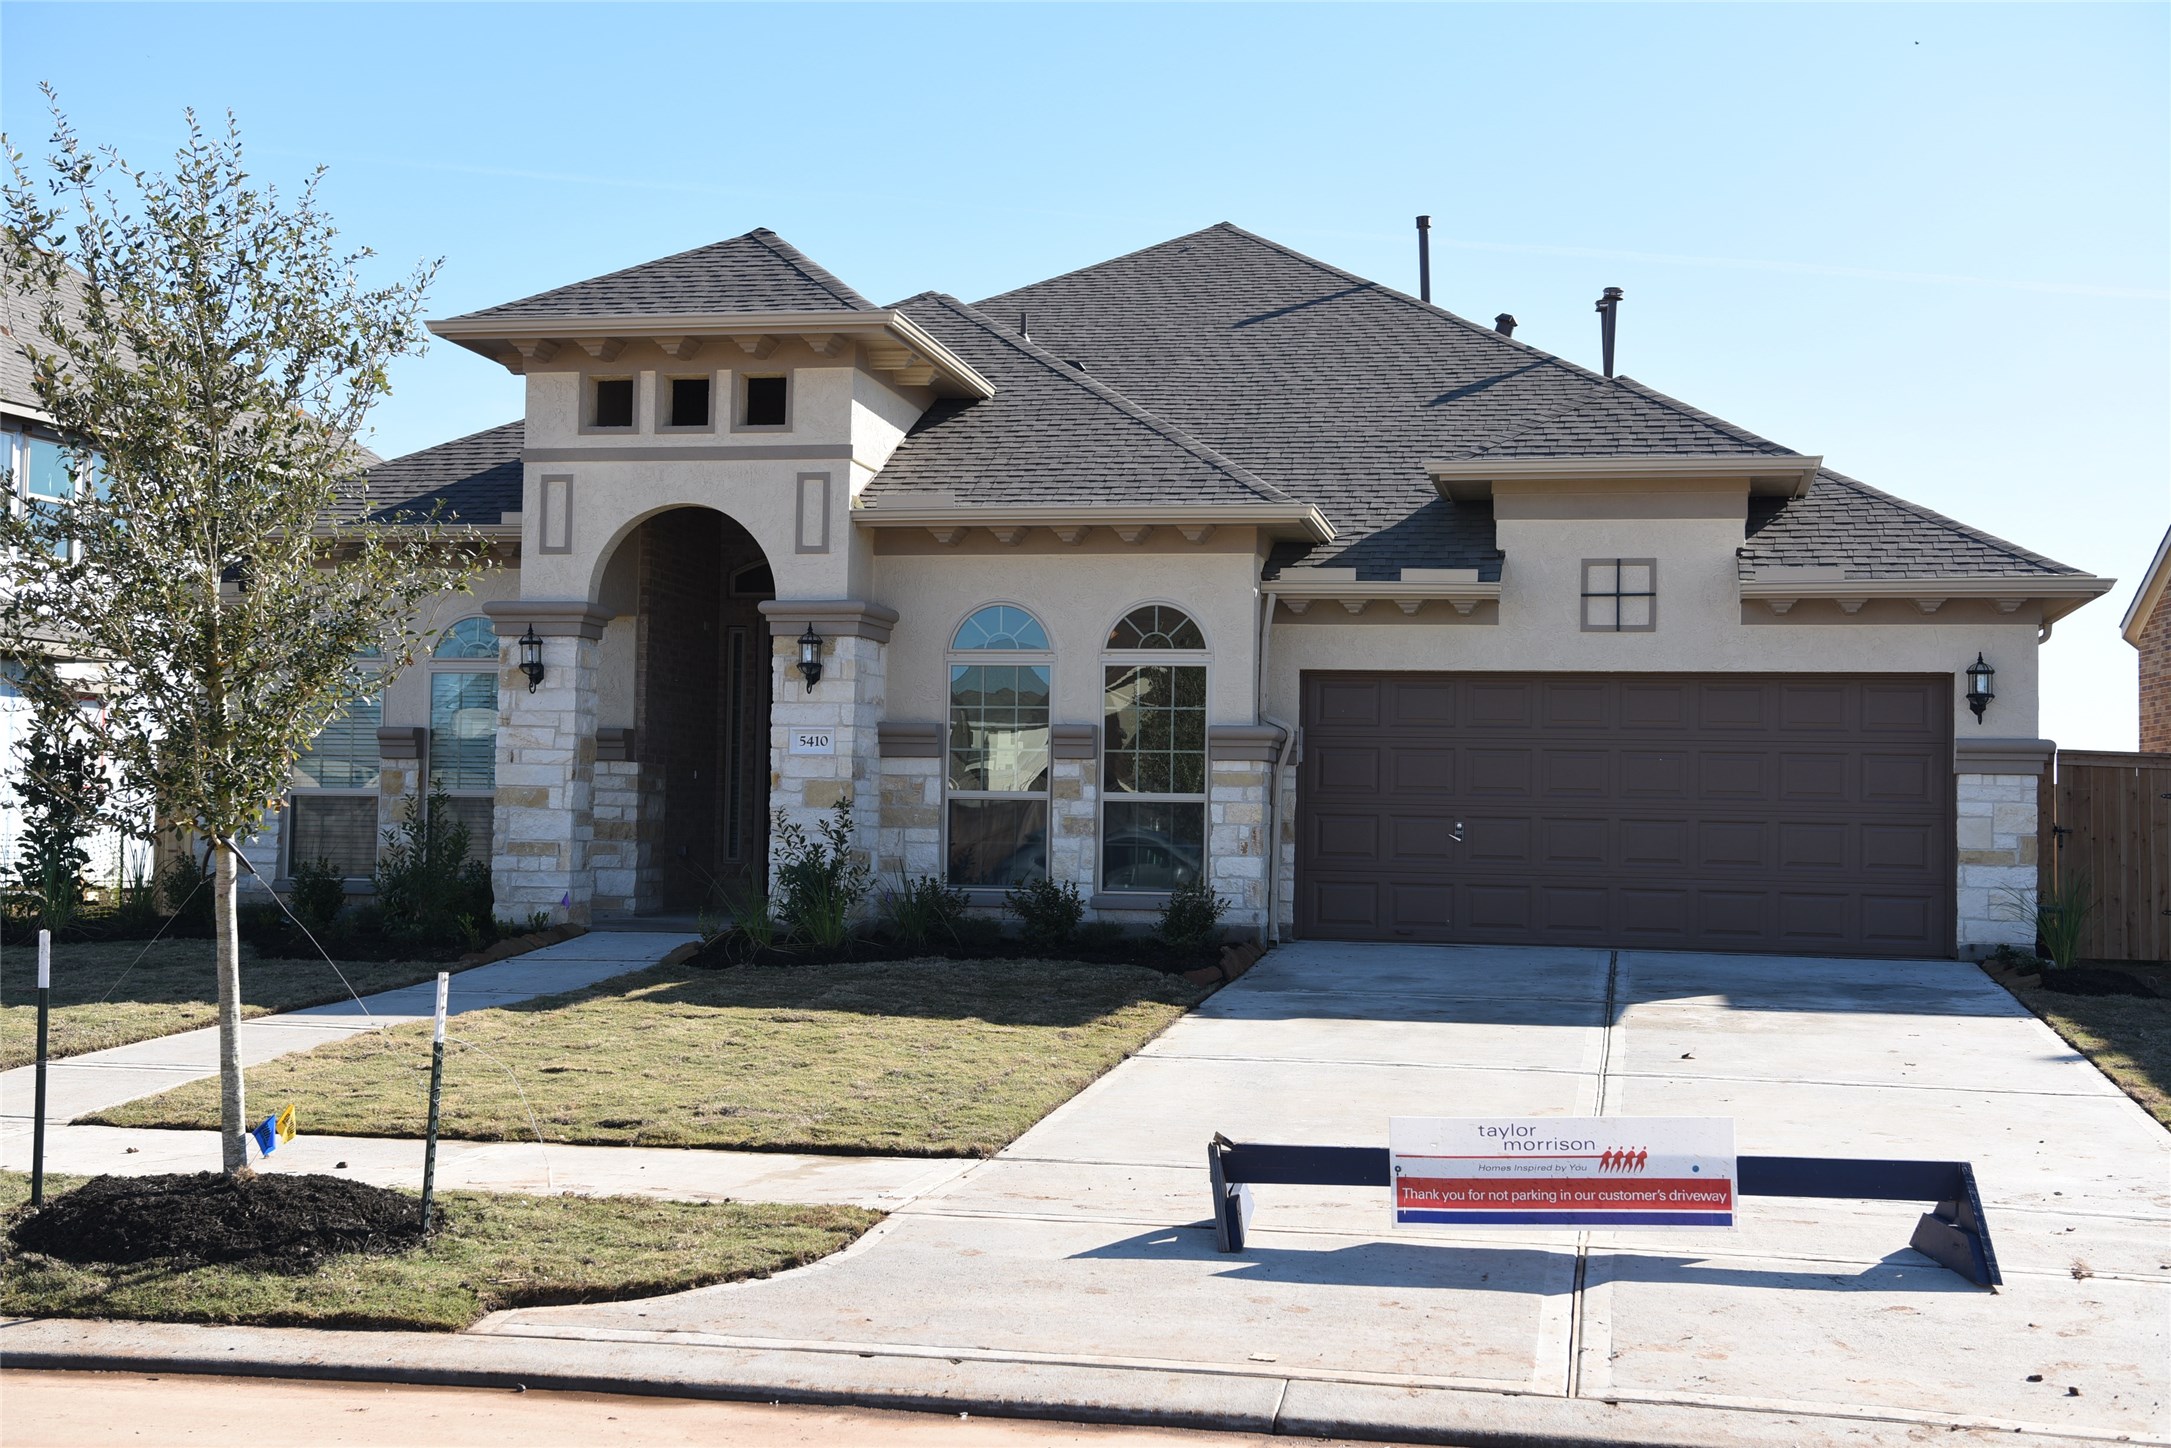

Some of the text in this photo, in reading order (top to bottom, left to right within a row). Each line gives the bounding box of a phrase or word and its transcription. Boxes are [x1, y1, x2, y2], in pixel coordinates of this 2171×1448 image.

[799, 735, 829, 747] 5410
[1478, 1123, 1537, 1139] taylor
[1503, 1137, 1596, 1151] morrison
[1478, 1164, 1588, 1173] Homes Inspired by You
[1402, 1187, 1440, 1200] Thank
[1442, 1191, 1465, 1202] you
[1468, 1188, 1484, 1200] for
[1488, 1190, 1508, 1200] not
[1511, 1189, 1557, 1204] parking
[1560, 1189, 1572, 1200] in
[1574, 1191, 1596, 1201] our
[1668, 1189, 1727, 1204] driveway
